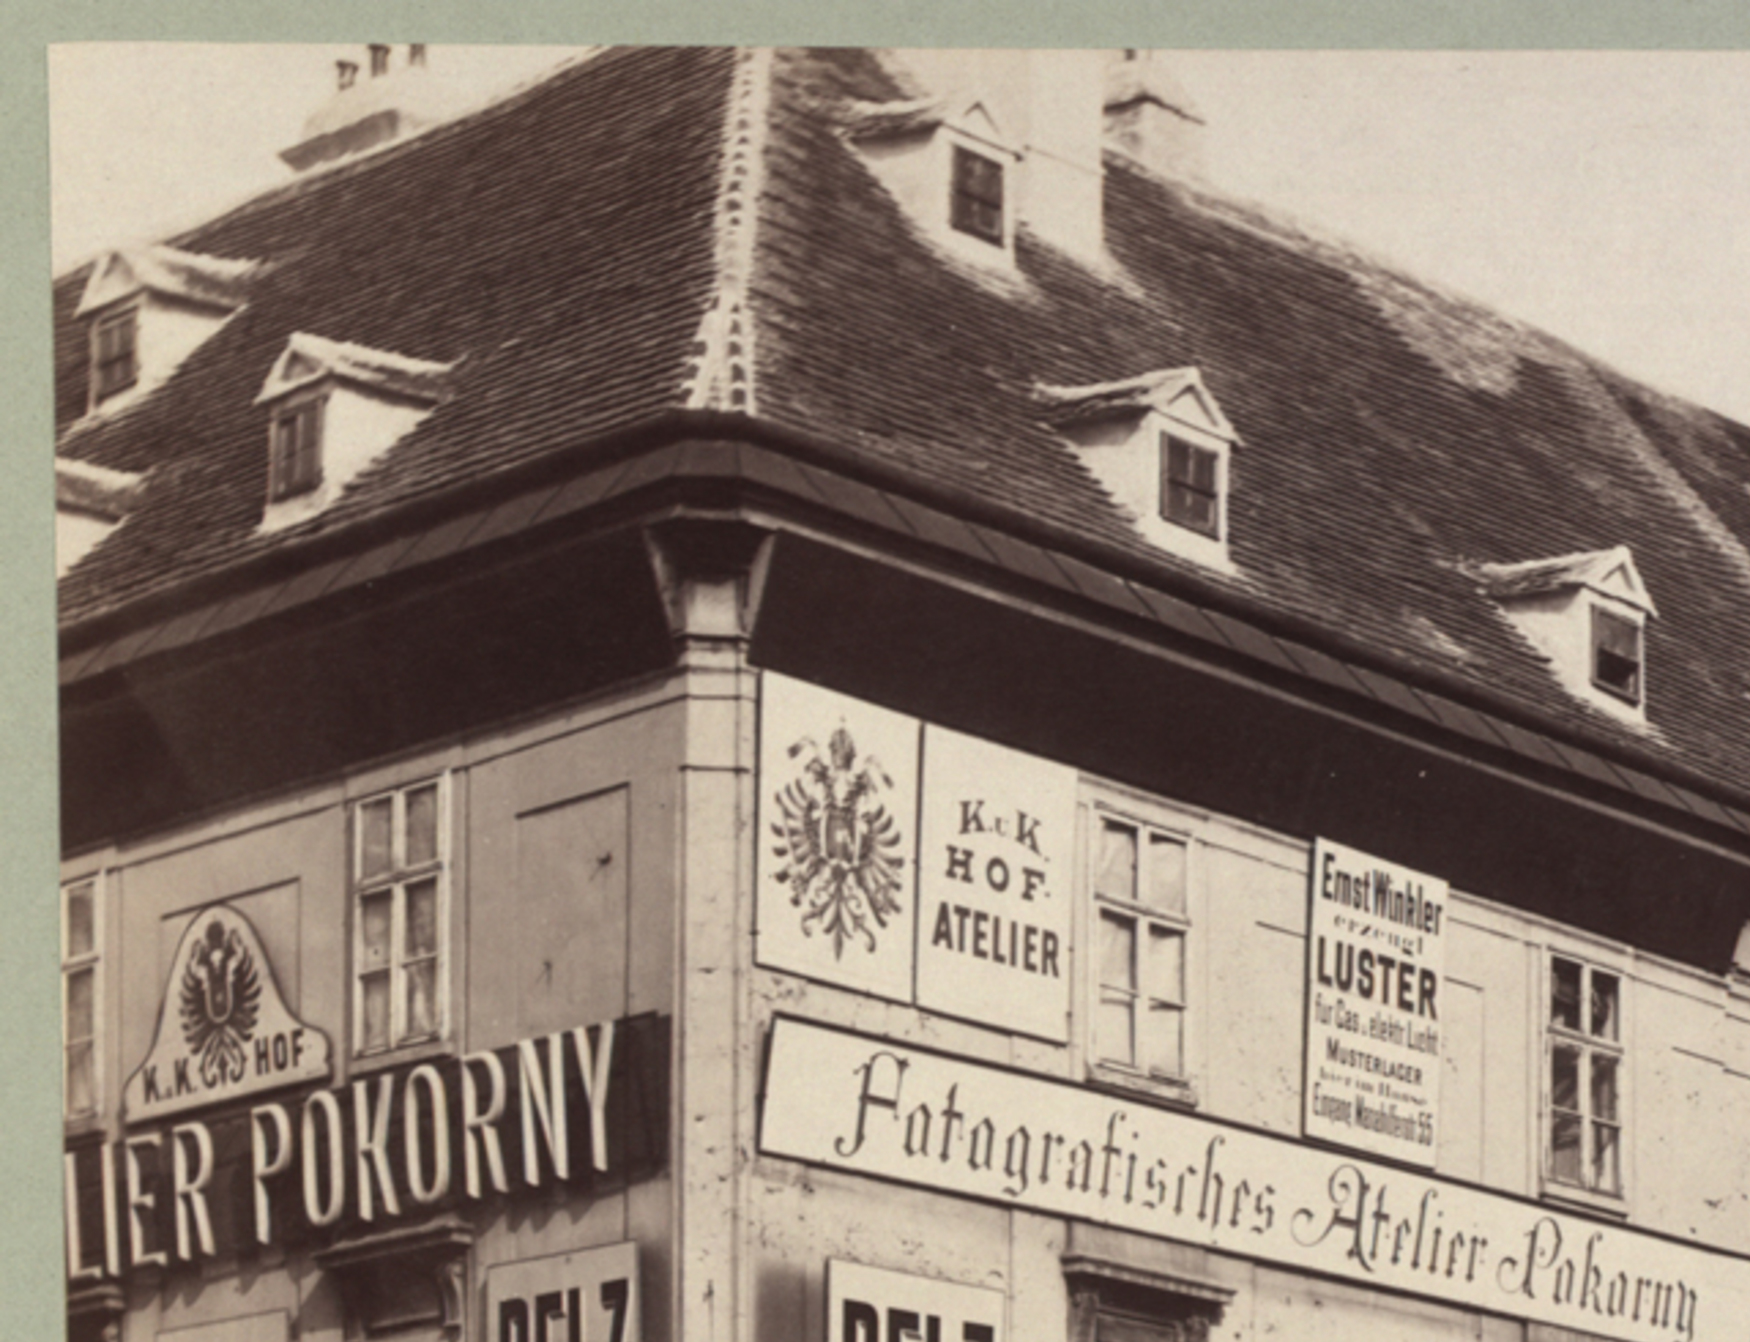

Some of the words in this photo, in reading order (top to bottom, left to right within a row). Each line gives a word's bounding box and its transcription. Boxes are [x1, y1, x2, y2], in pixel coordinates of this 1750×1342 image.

[932, 900, 1059, 978] ATELIER
[1372, 867, 1443, 935] Winkler
[252, 1020, 614, 1245] POKORNY
[834, 1050, 1276, 1235] Fotografisches
[1291, 1164, 1488, 1283] Atelier
